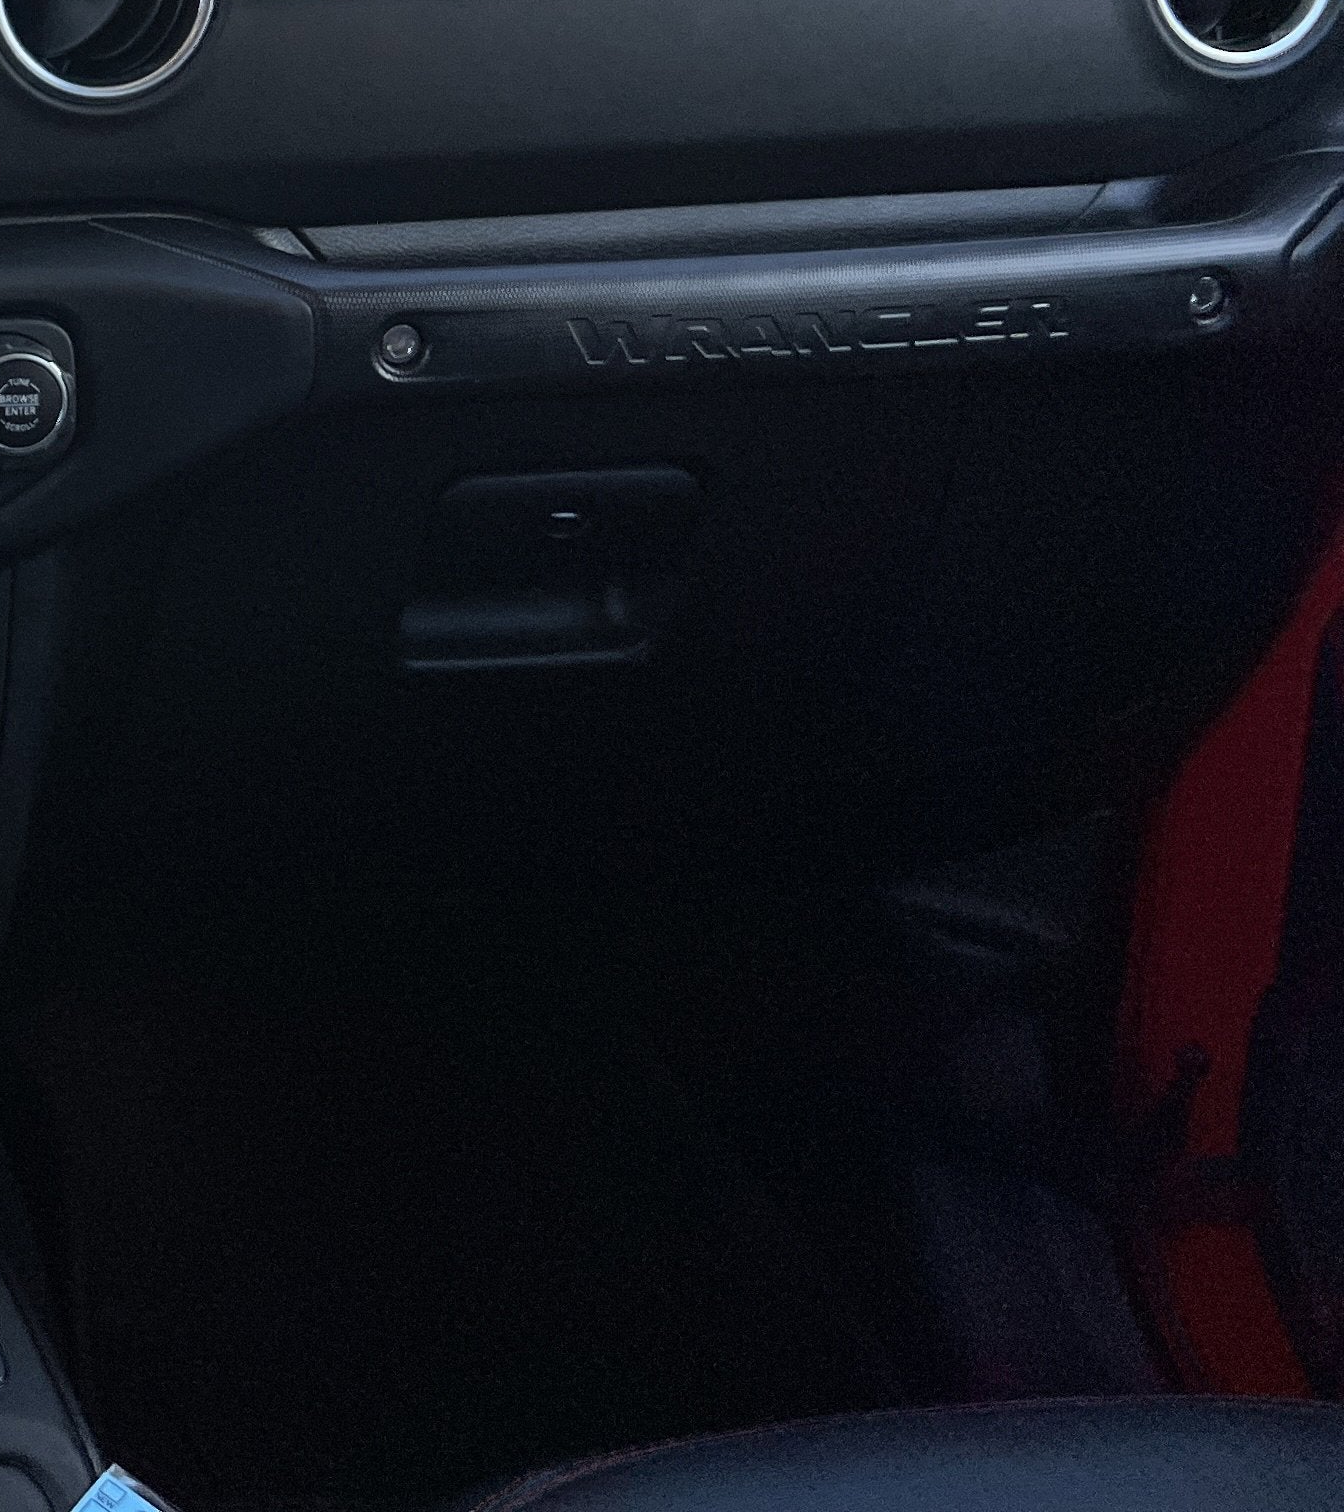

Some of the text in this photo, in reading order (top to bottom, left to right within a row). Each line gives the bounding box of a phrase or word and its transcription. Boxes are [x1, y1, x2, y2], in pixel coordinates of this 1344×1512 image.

[566, 293, 1072, 365] WRANGLER
[0, 393, 40, 405] BROWSE
[4, 406, 37, 417] ENTER
